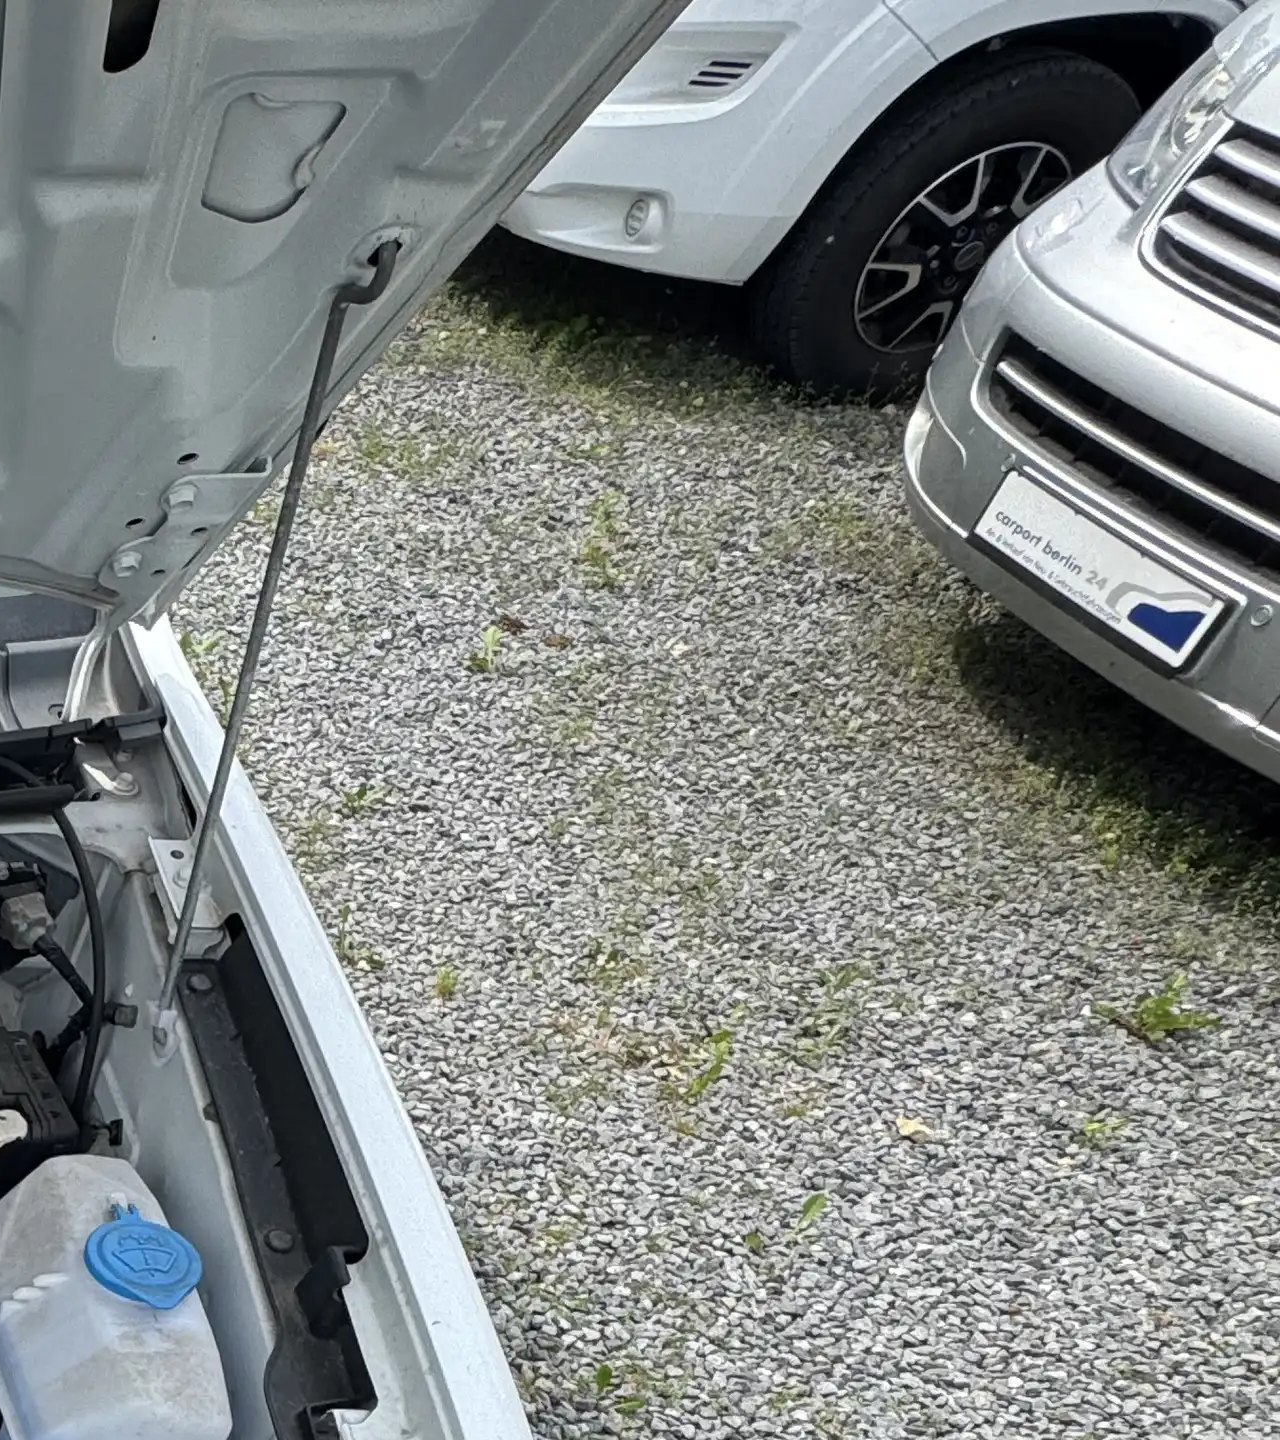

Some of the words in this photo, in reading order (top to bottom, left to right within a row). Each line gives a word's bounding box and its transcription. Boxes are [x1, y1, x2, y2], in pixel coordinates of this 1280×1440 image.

[995, 510, 1043, 547] carport
[1042, 540, 1083, 576] berlin
[1085, 570, 1109, 592] 24
